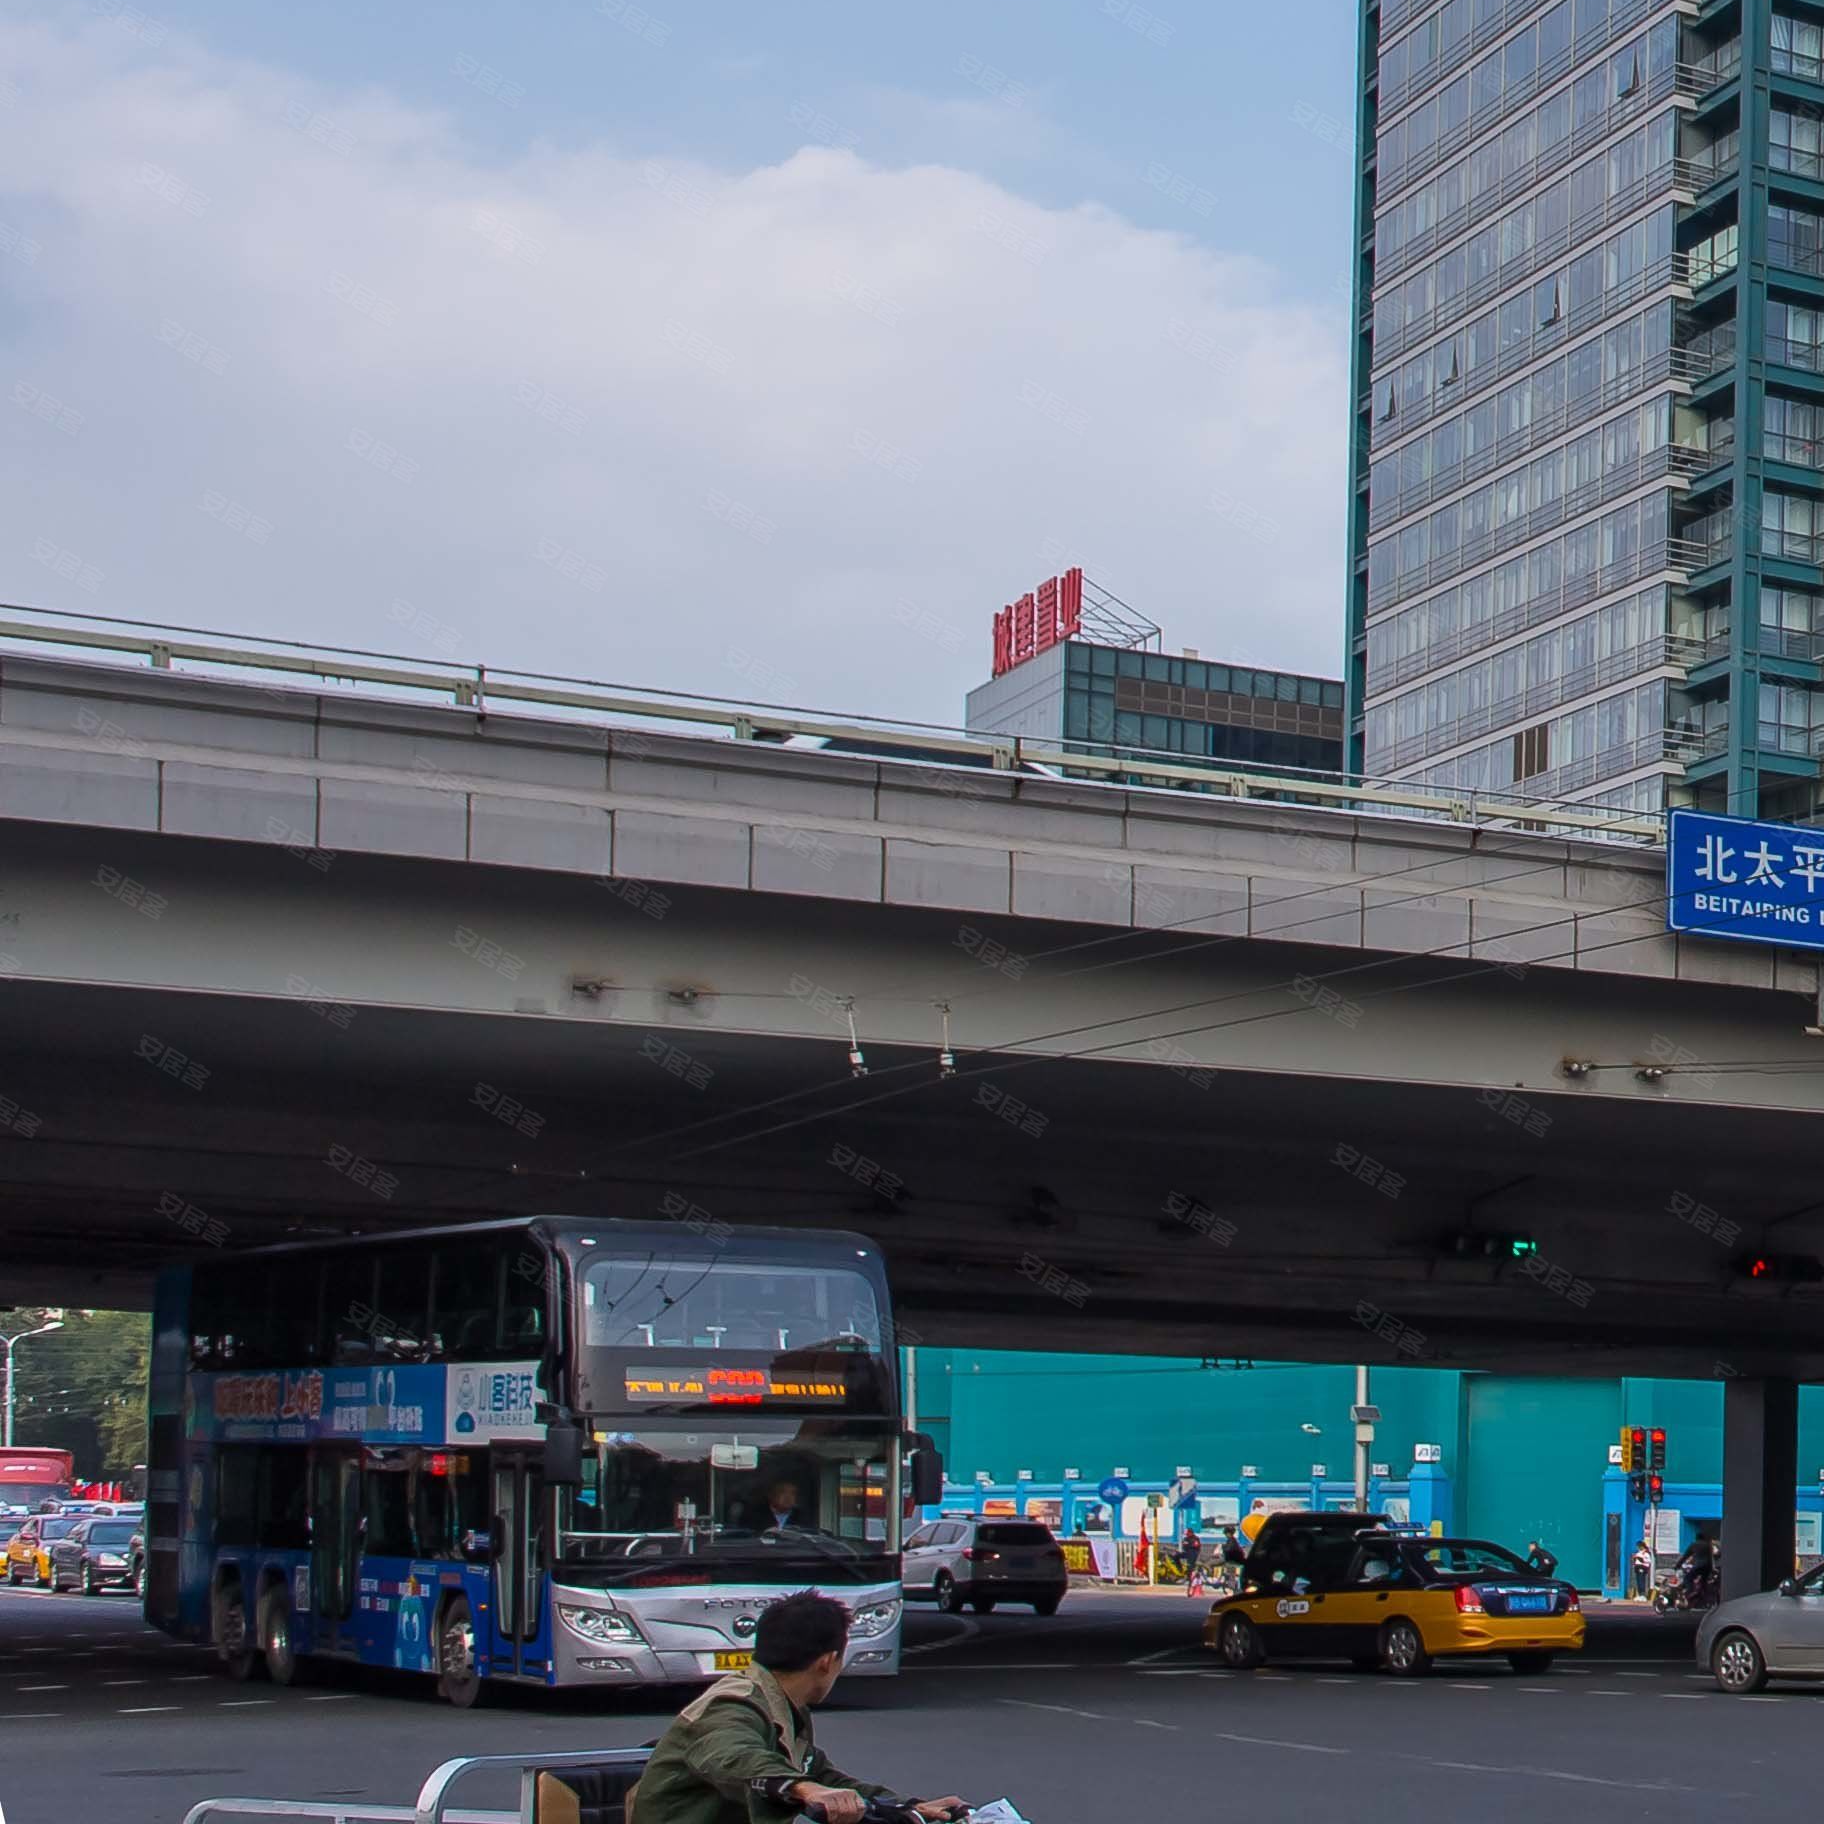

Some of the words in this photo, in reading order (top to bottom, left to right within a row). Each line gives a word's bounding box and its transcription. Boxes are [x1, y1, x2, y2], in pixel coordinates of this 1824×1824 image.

[992, 567, 1082, 679] 城建置业
[1694, 892, 1810, 925] BEITAIPING
[703, 1597, 775, 1611] FOTO
